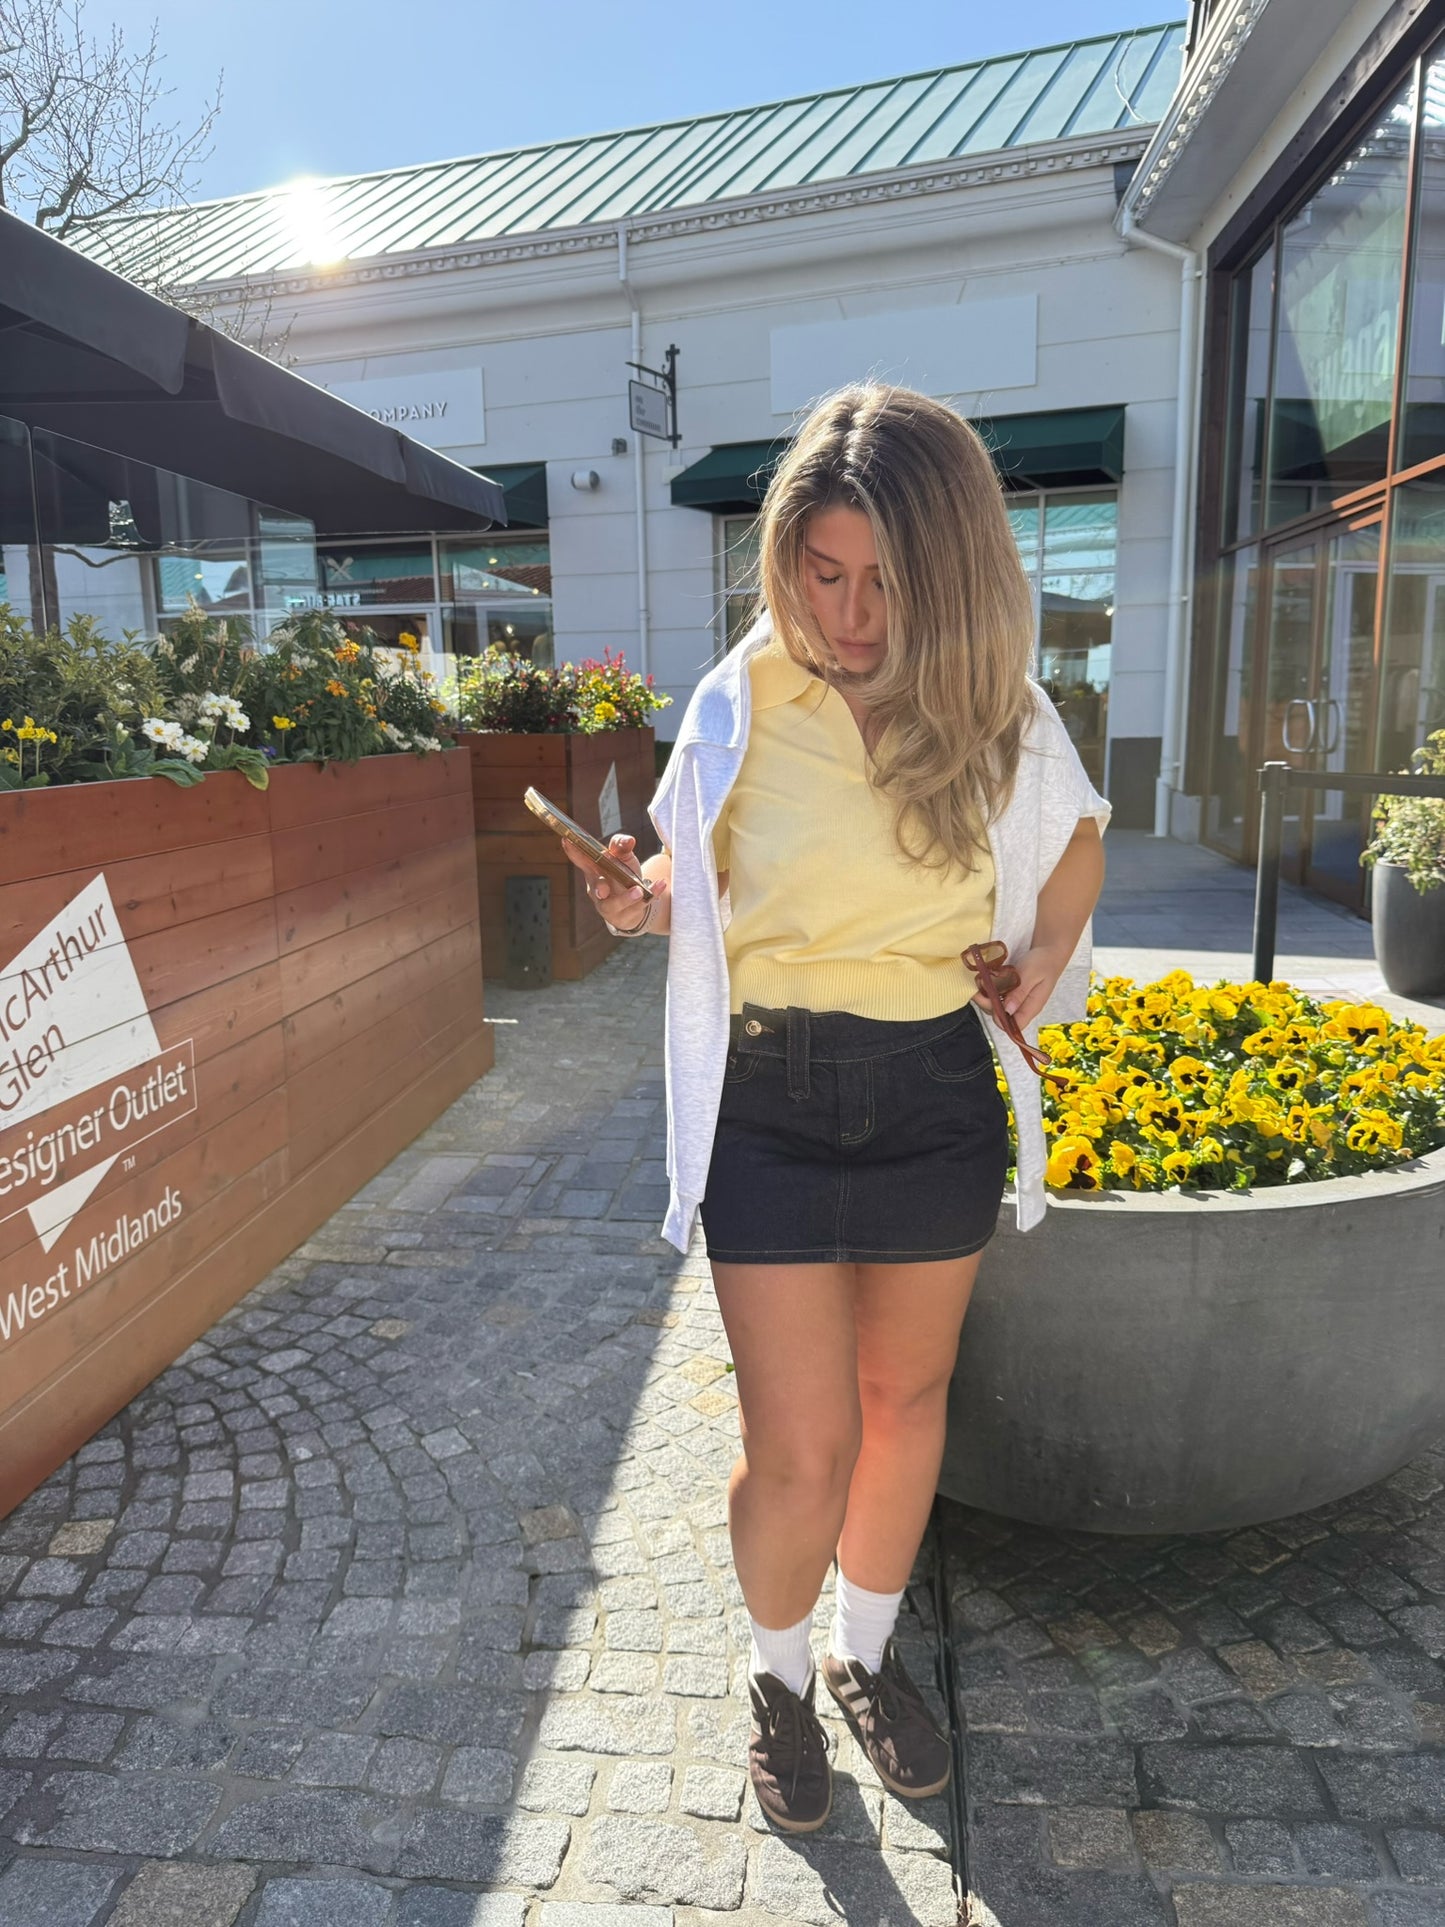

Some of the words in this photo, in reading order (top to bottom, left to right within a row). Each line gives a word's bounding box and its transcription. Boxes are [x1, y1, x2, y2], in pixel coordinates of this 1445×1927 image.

[0, 1024, 66, 1111] Glen
[109, 1061, 188, 1131] Outlet
[0, 1263, 71, 1340] West
[75, 1186, 182, 1288] Midlands
